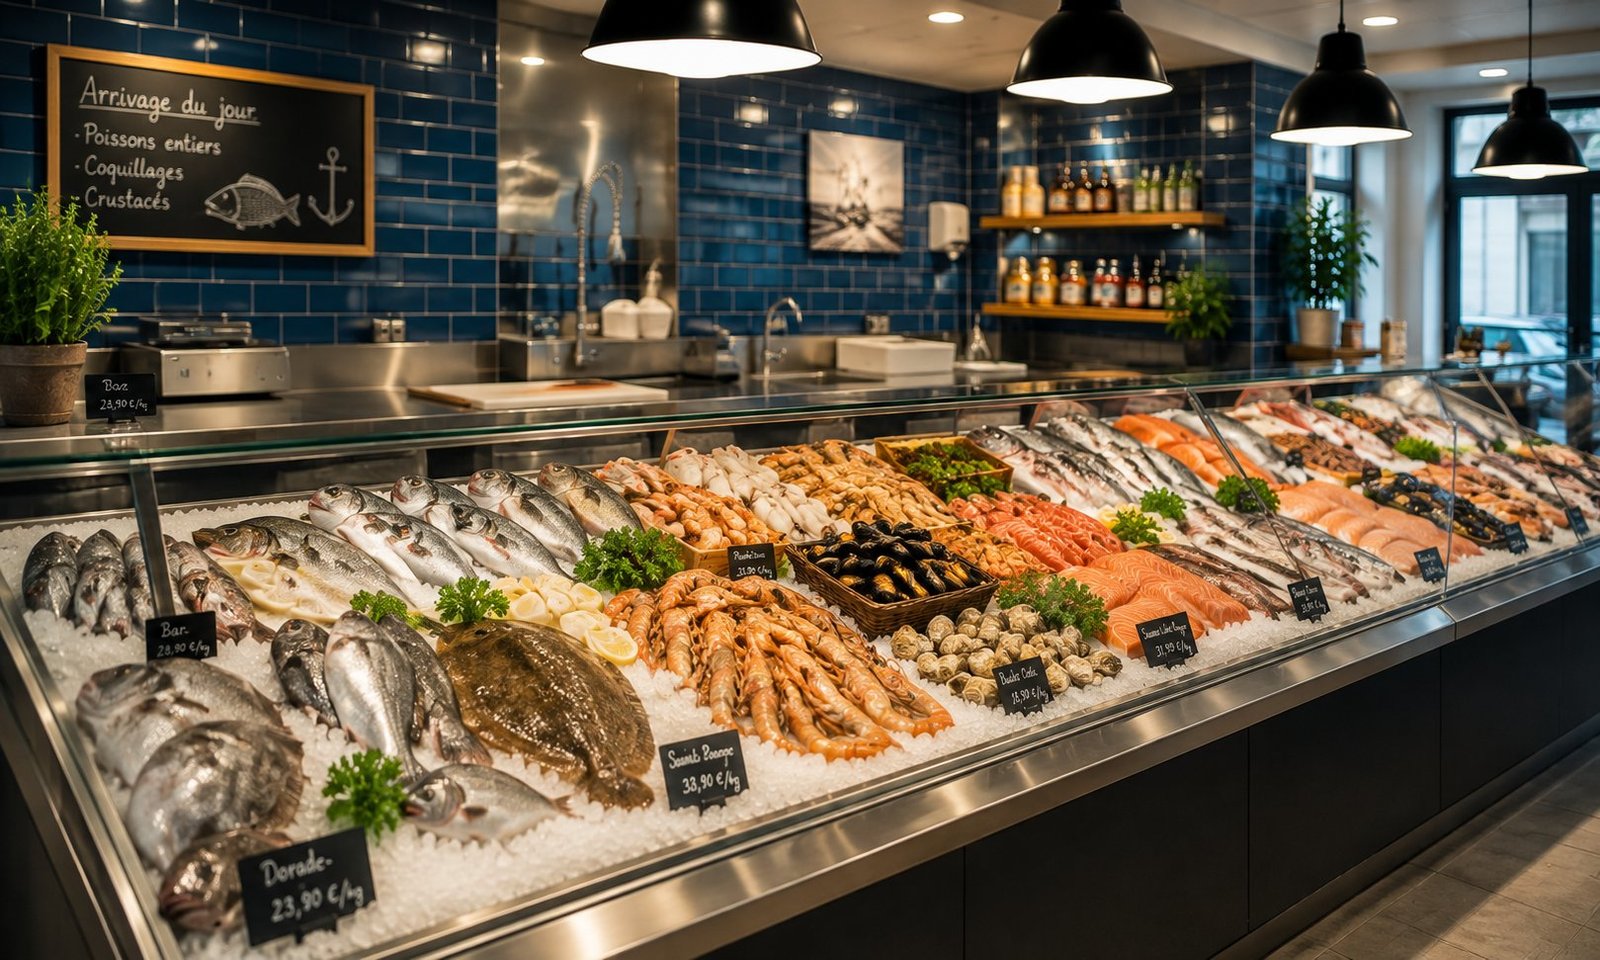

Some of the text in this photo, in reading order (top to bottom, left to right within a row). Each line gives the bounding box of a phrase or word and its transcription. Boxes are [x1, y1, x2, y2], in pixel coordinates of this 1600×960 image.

[79, 75, 171, 123] Arrivage
[181, 88, 207, 115] du
[84, 122, 222, 155] Poissons entiers
[84, 155, 184, 189] Coquillages
[85, 185, 170, 211] Crustacés
[271, 887, 323, 922] 23,90
